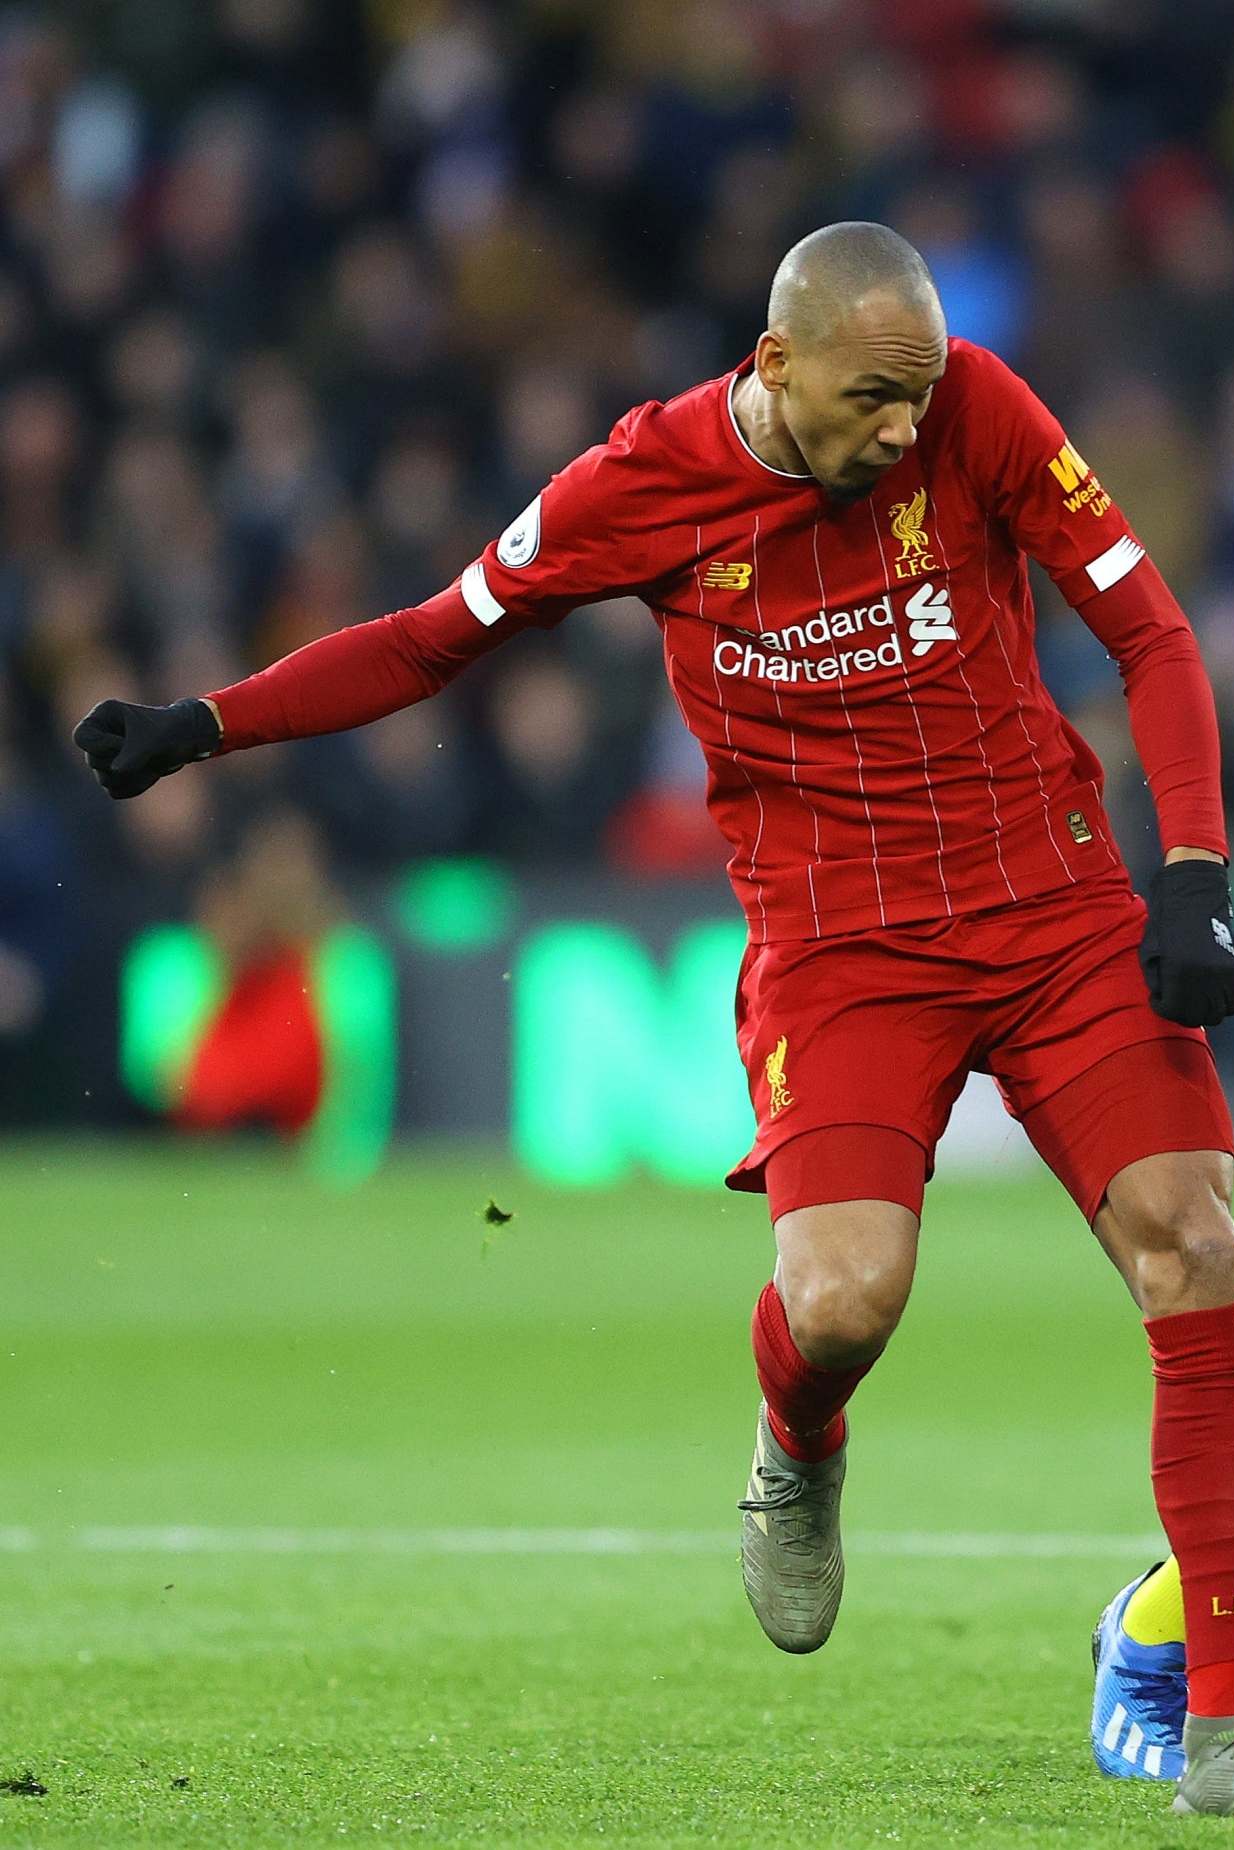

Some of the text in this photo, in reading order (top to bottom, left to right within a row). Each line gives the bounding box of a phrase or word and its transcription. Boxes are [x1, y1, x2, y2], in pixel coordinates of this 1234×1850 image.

[1062, 476, 1105, 513] West
[735, 595, 895, 652] andard
[713, 632, 903, 683] Chartered
